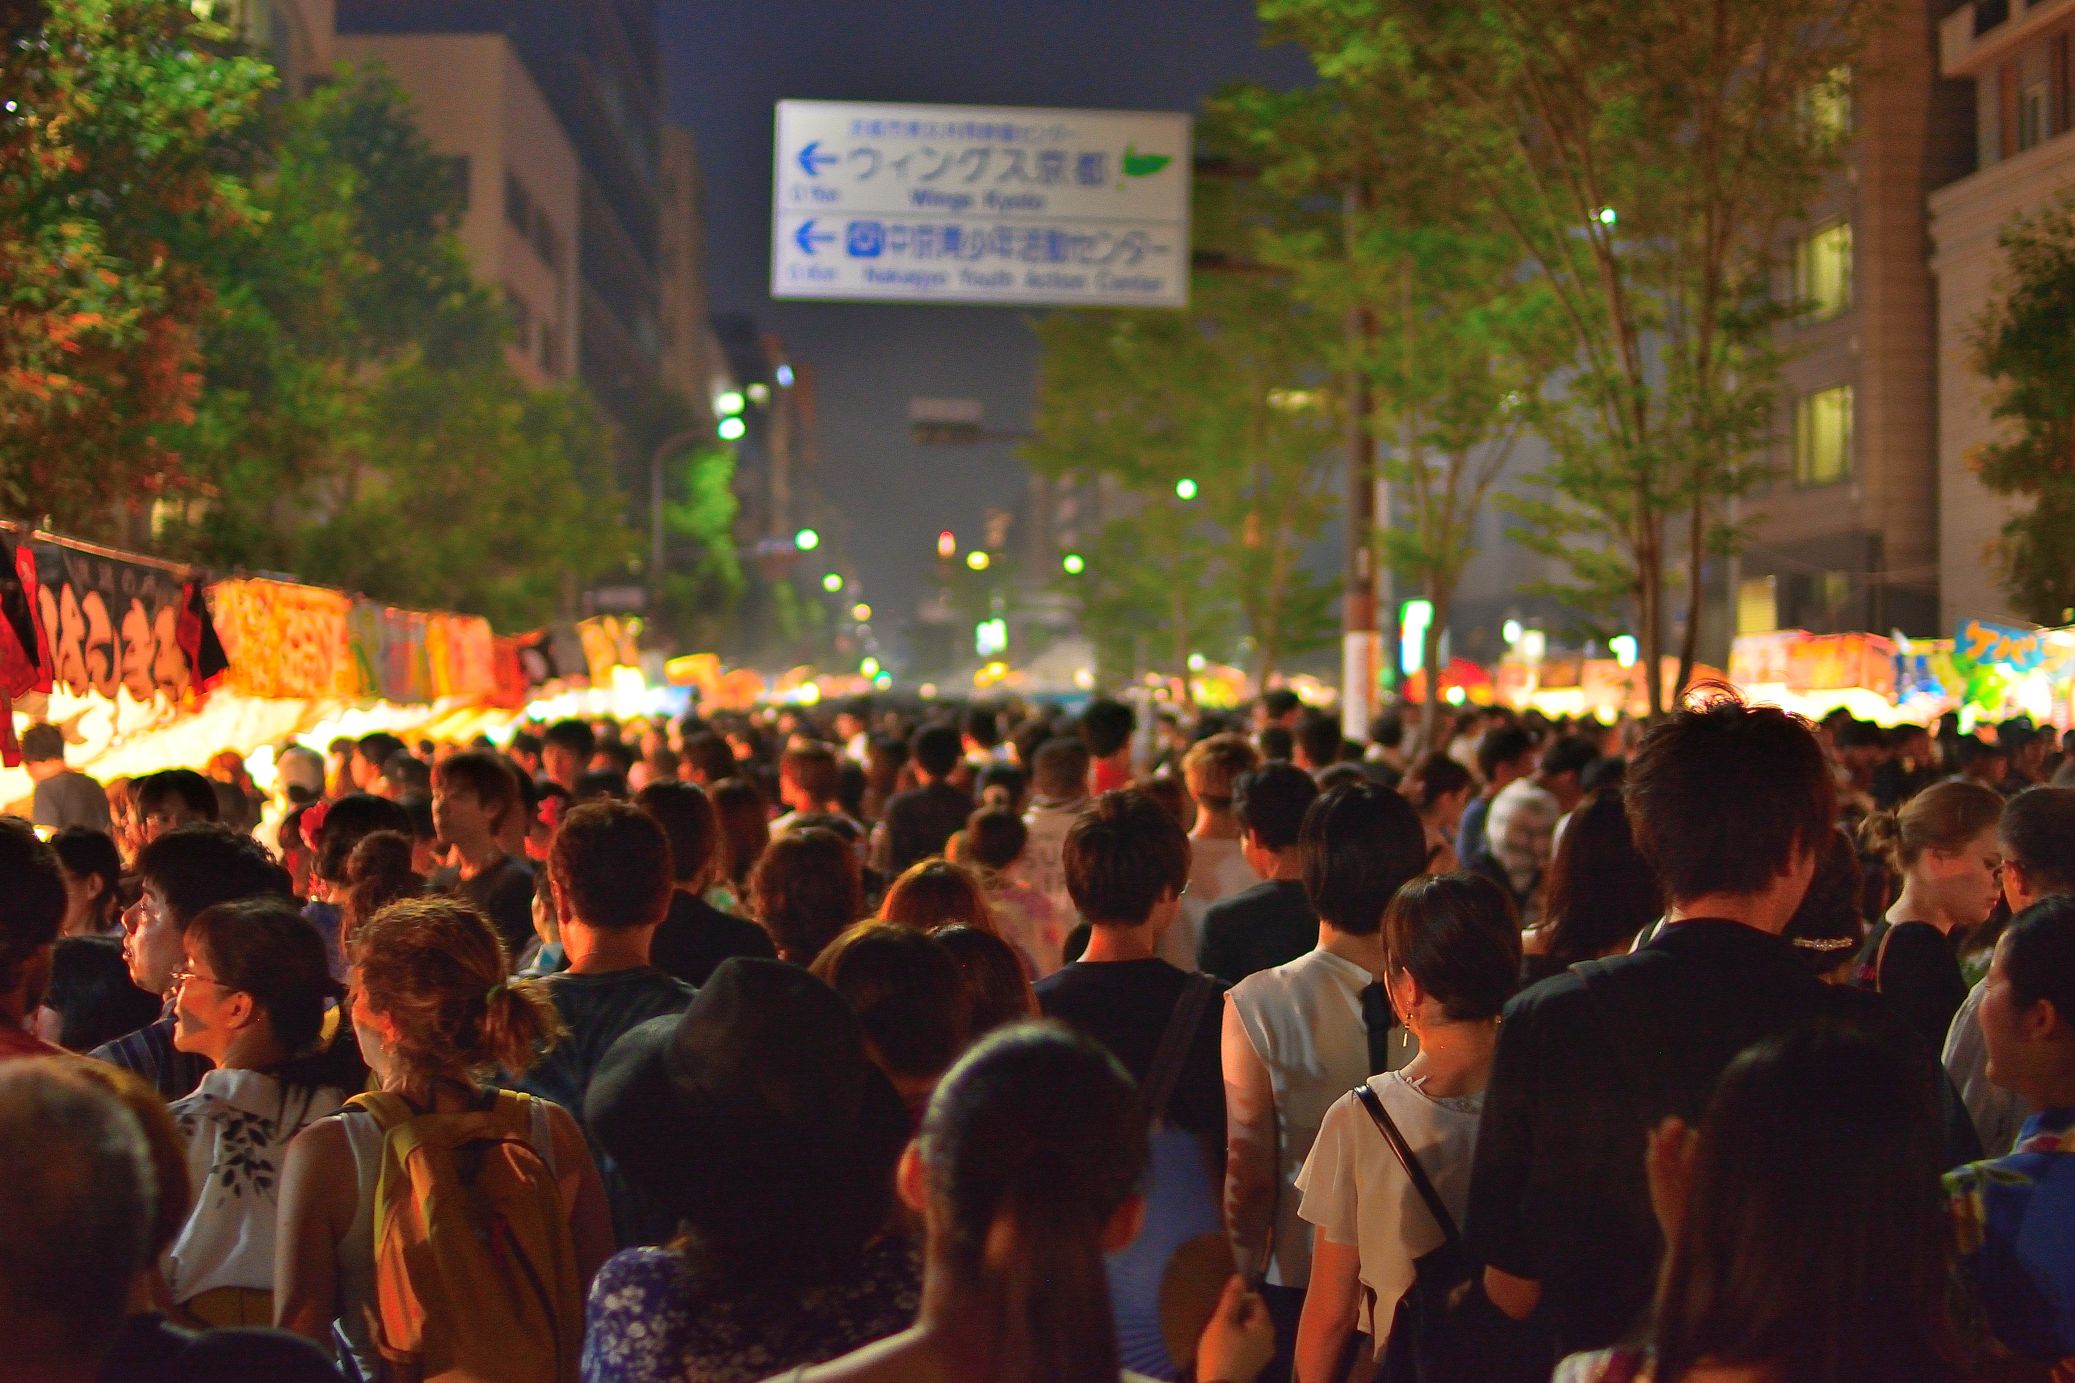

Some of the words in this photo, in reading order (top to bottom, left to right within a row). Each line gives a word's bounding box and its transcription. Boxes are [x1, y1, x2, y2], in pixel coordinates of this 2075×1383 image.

[846, 146, 1108, 187] ウィングス京都
